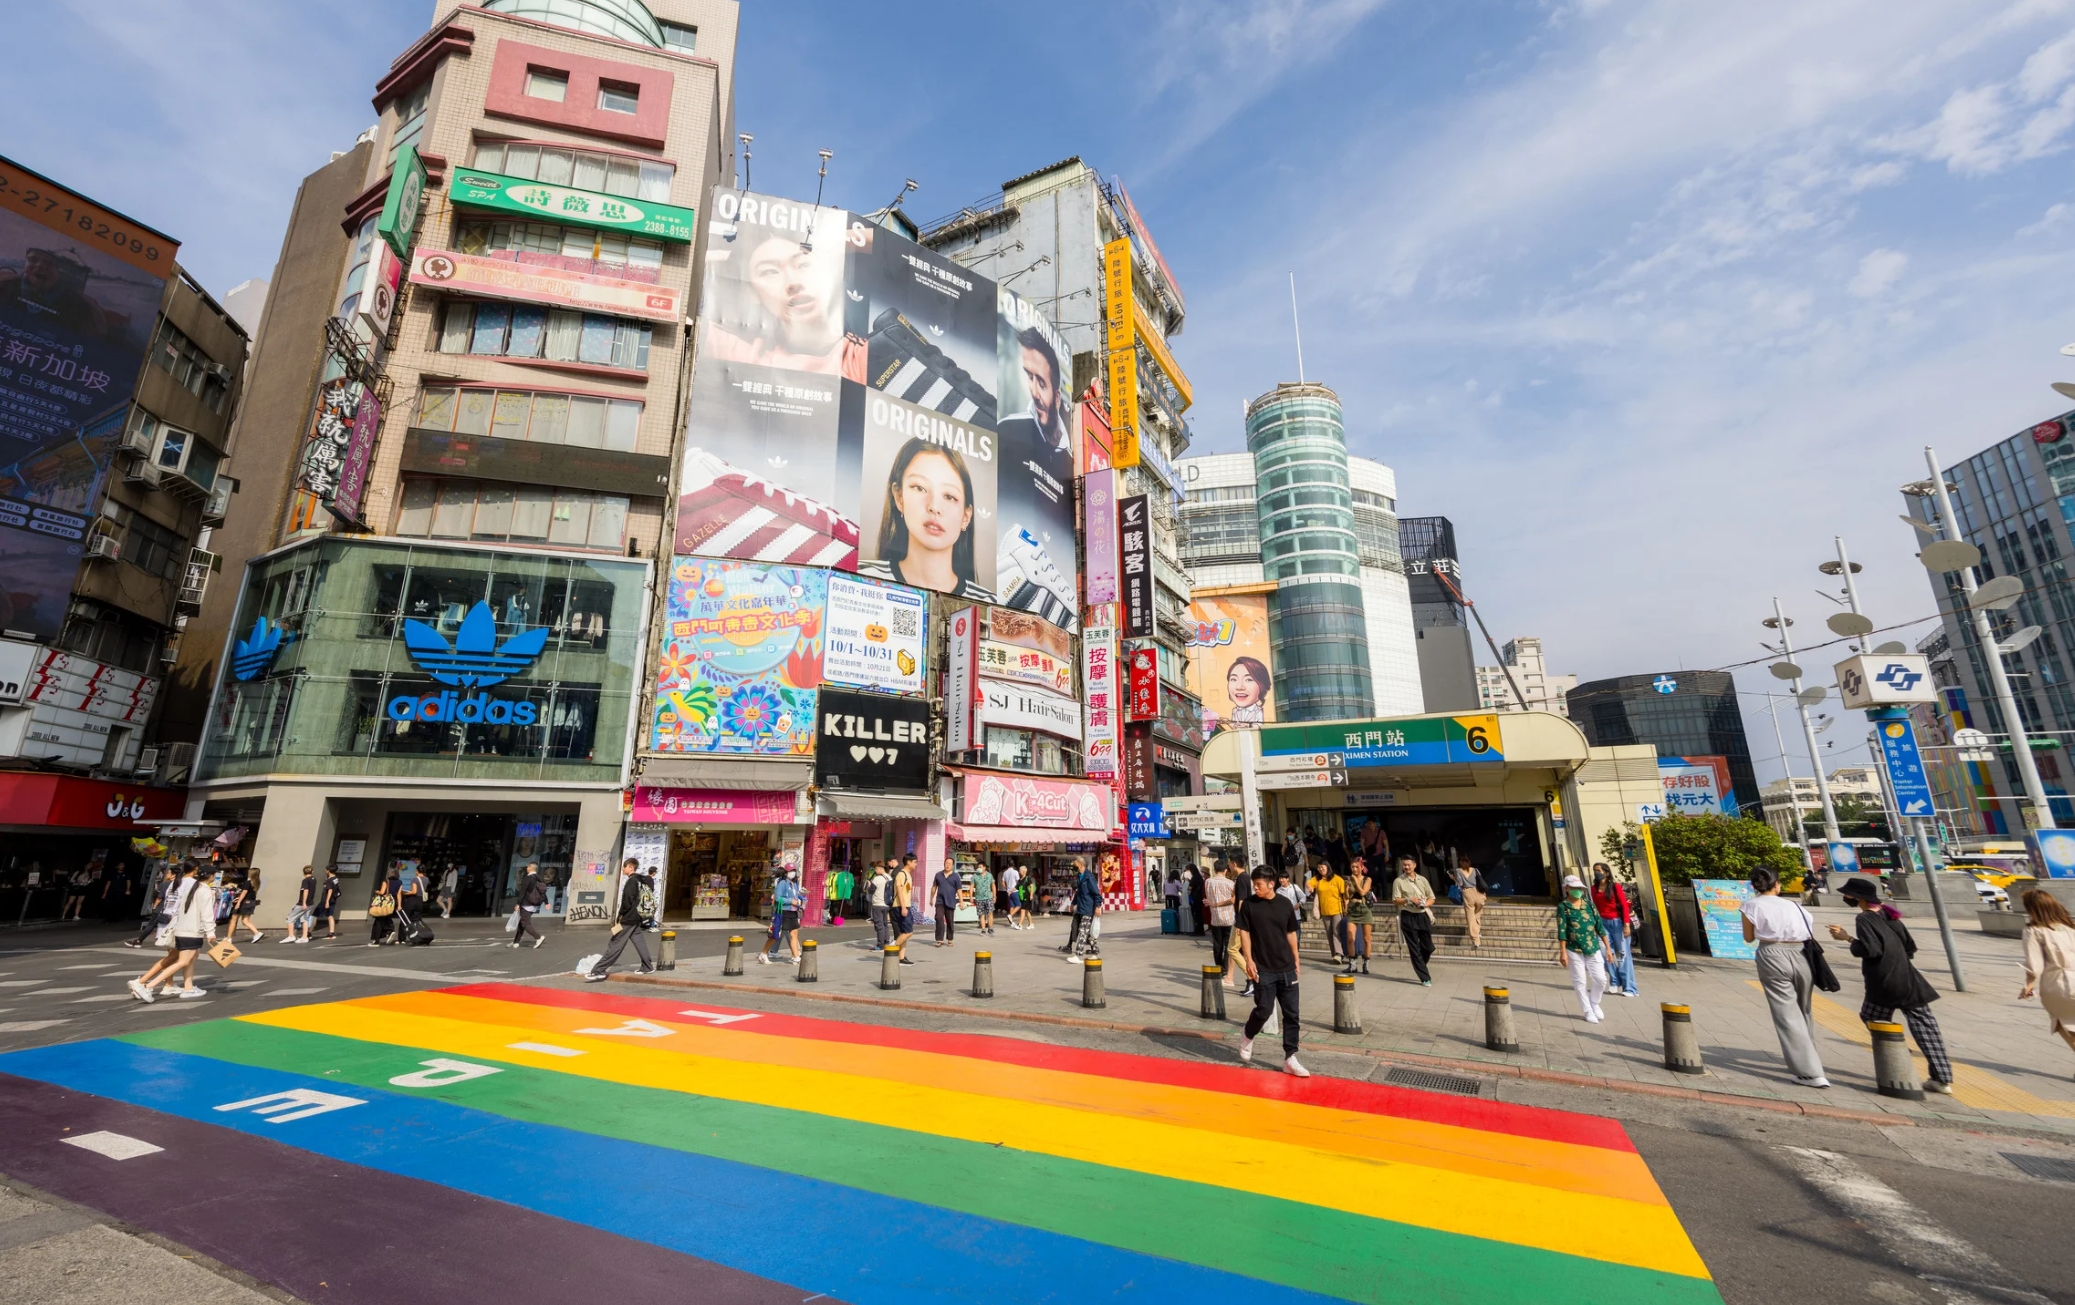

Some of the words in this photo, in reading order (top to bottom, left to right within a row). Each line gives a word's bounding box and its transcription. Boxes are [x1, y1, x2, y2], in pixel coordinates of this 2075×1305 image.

[467, 189, 496, 201] SPA
[524, 188, 627, 220] 詩薇思
[644, 220, 690, 238] 2388-8155
[718, 193, 867, 247] ORIGINS
[650, 299, 669, 307] 6F
[1114, 302, 1124, 332] HOTEL
[1003, 292, 1070, 366] ORIGINALS
[0, 335, 110, 393] 新加坡
[875, 358, 902, 388] SUPERSTAR
[774, 385, 833, 403] 千種原創故事
[872, 398, 993, 462] ORIGINALS
[682, 513, 728, 548] GAZELLE
[1092, 510, 1106, 555] 湯の花
[1002, 575, 1023, 599] SAMBA
[700, 595, 787, 613] 萬華文化嘉年華
[673, 608, 813, 637] 西門町青春文化季
[830, 639, 893, 661] 10/1~10/31
[1019, 653, 1041, 668] 按摩
[1089, 647, 1108, 681] 按摩
[388, 690, 537, 725] adidas
[1020, 697, 1050, 717] Hair
[1050, 704, 1074, 725] Salon
[1089, 693, 1108, 727] 護膚
[824, 713, 926, 744] KILLER
[1344, 729, 1405, 750] 西門站
[1466, 726, 1489, 754] 6
[1090, 740, 1112, 757] 699
[1344, 751, 1371, 760] XIMEN
[1372, 750, 1409, 759] STATION
[1885, 740, 1905, 777] 服務中心
[1901, 743, 1919, 773] 旅遊
[1662, 774, 1711, 789] 存好股
[1544, 790, 1555, 803] 6
[1665, 792, 1715, 806] 找元大
